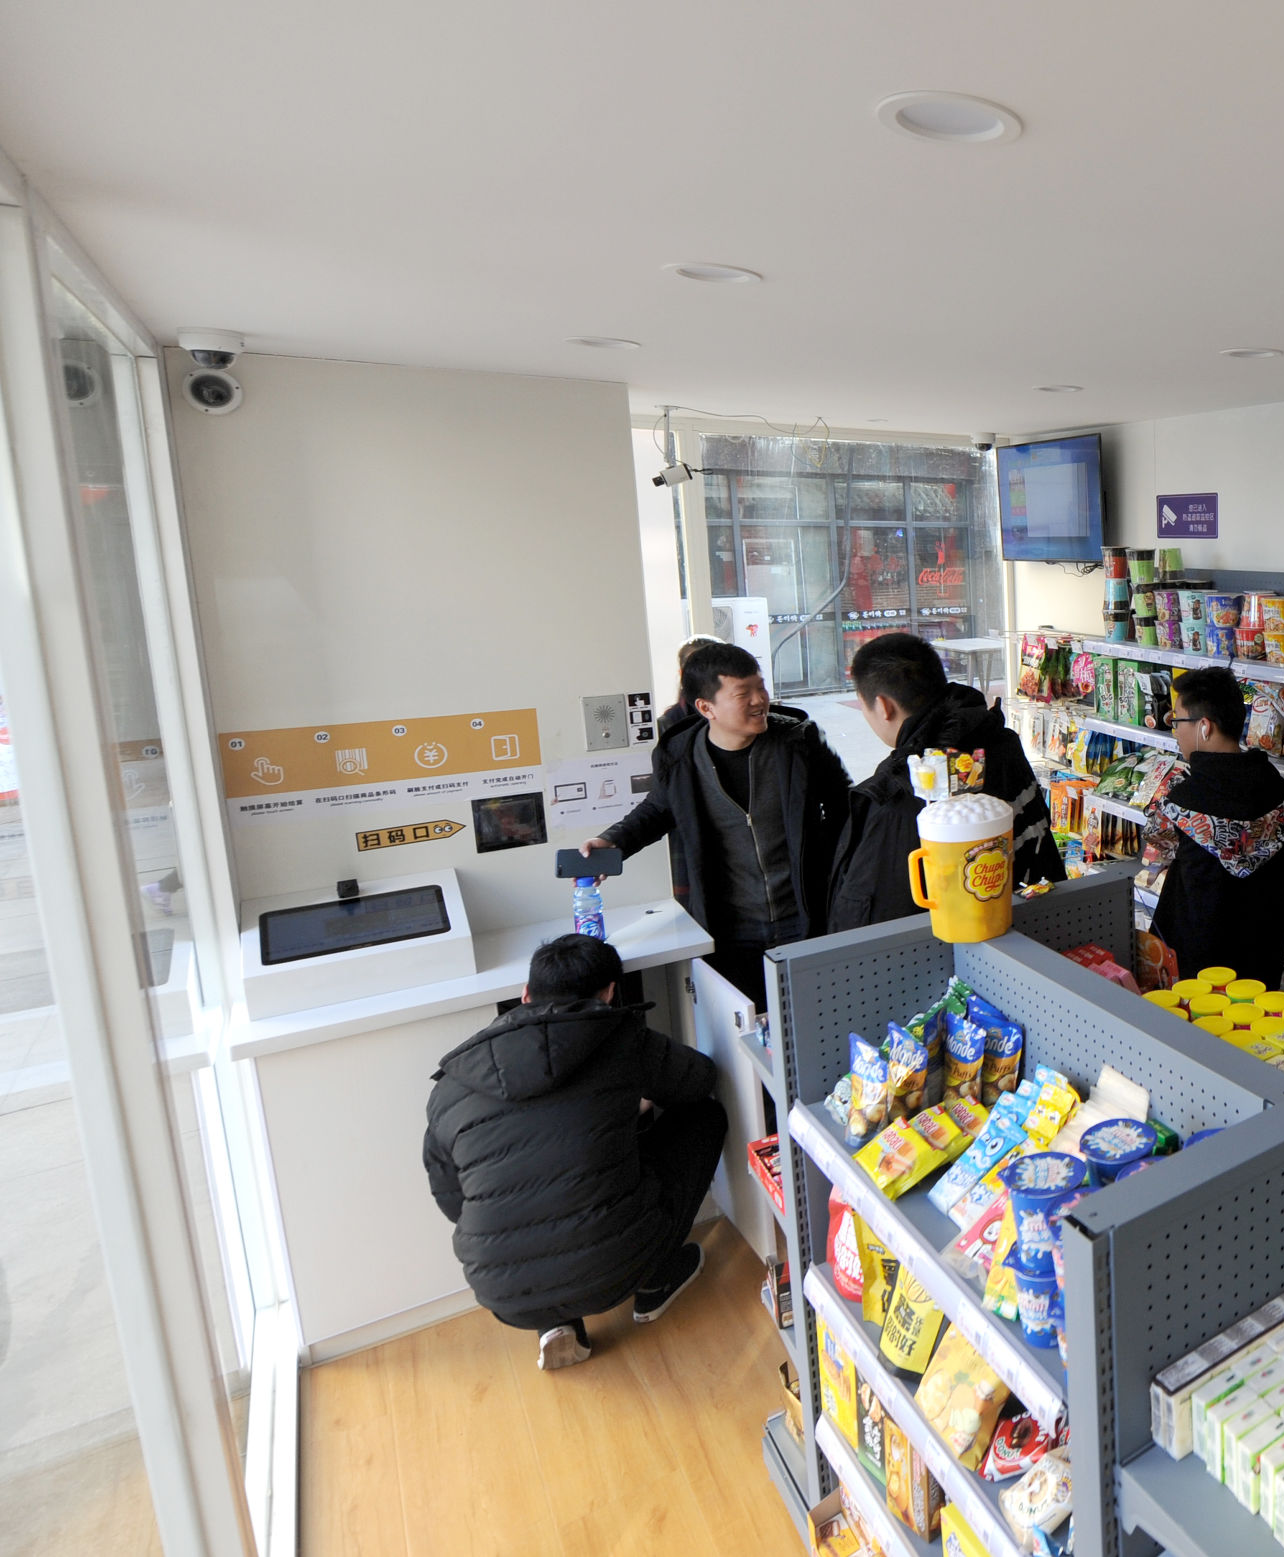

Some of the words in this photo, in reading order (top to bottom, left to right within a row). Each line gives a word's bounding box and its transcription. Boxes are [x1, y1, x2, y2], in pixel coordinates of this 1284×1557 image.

[361, 826, 430, 848] 扫码口
[974, 861, 1005, 875] Chupa
[972, 873, 1004, 889] Chups
[984, 1036, 1014, 1054] onde
